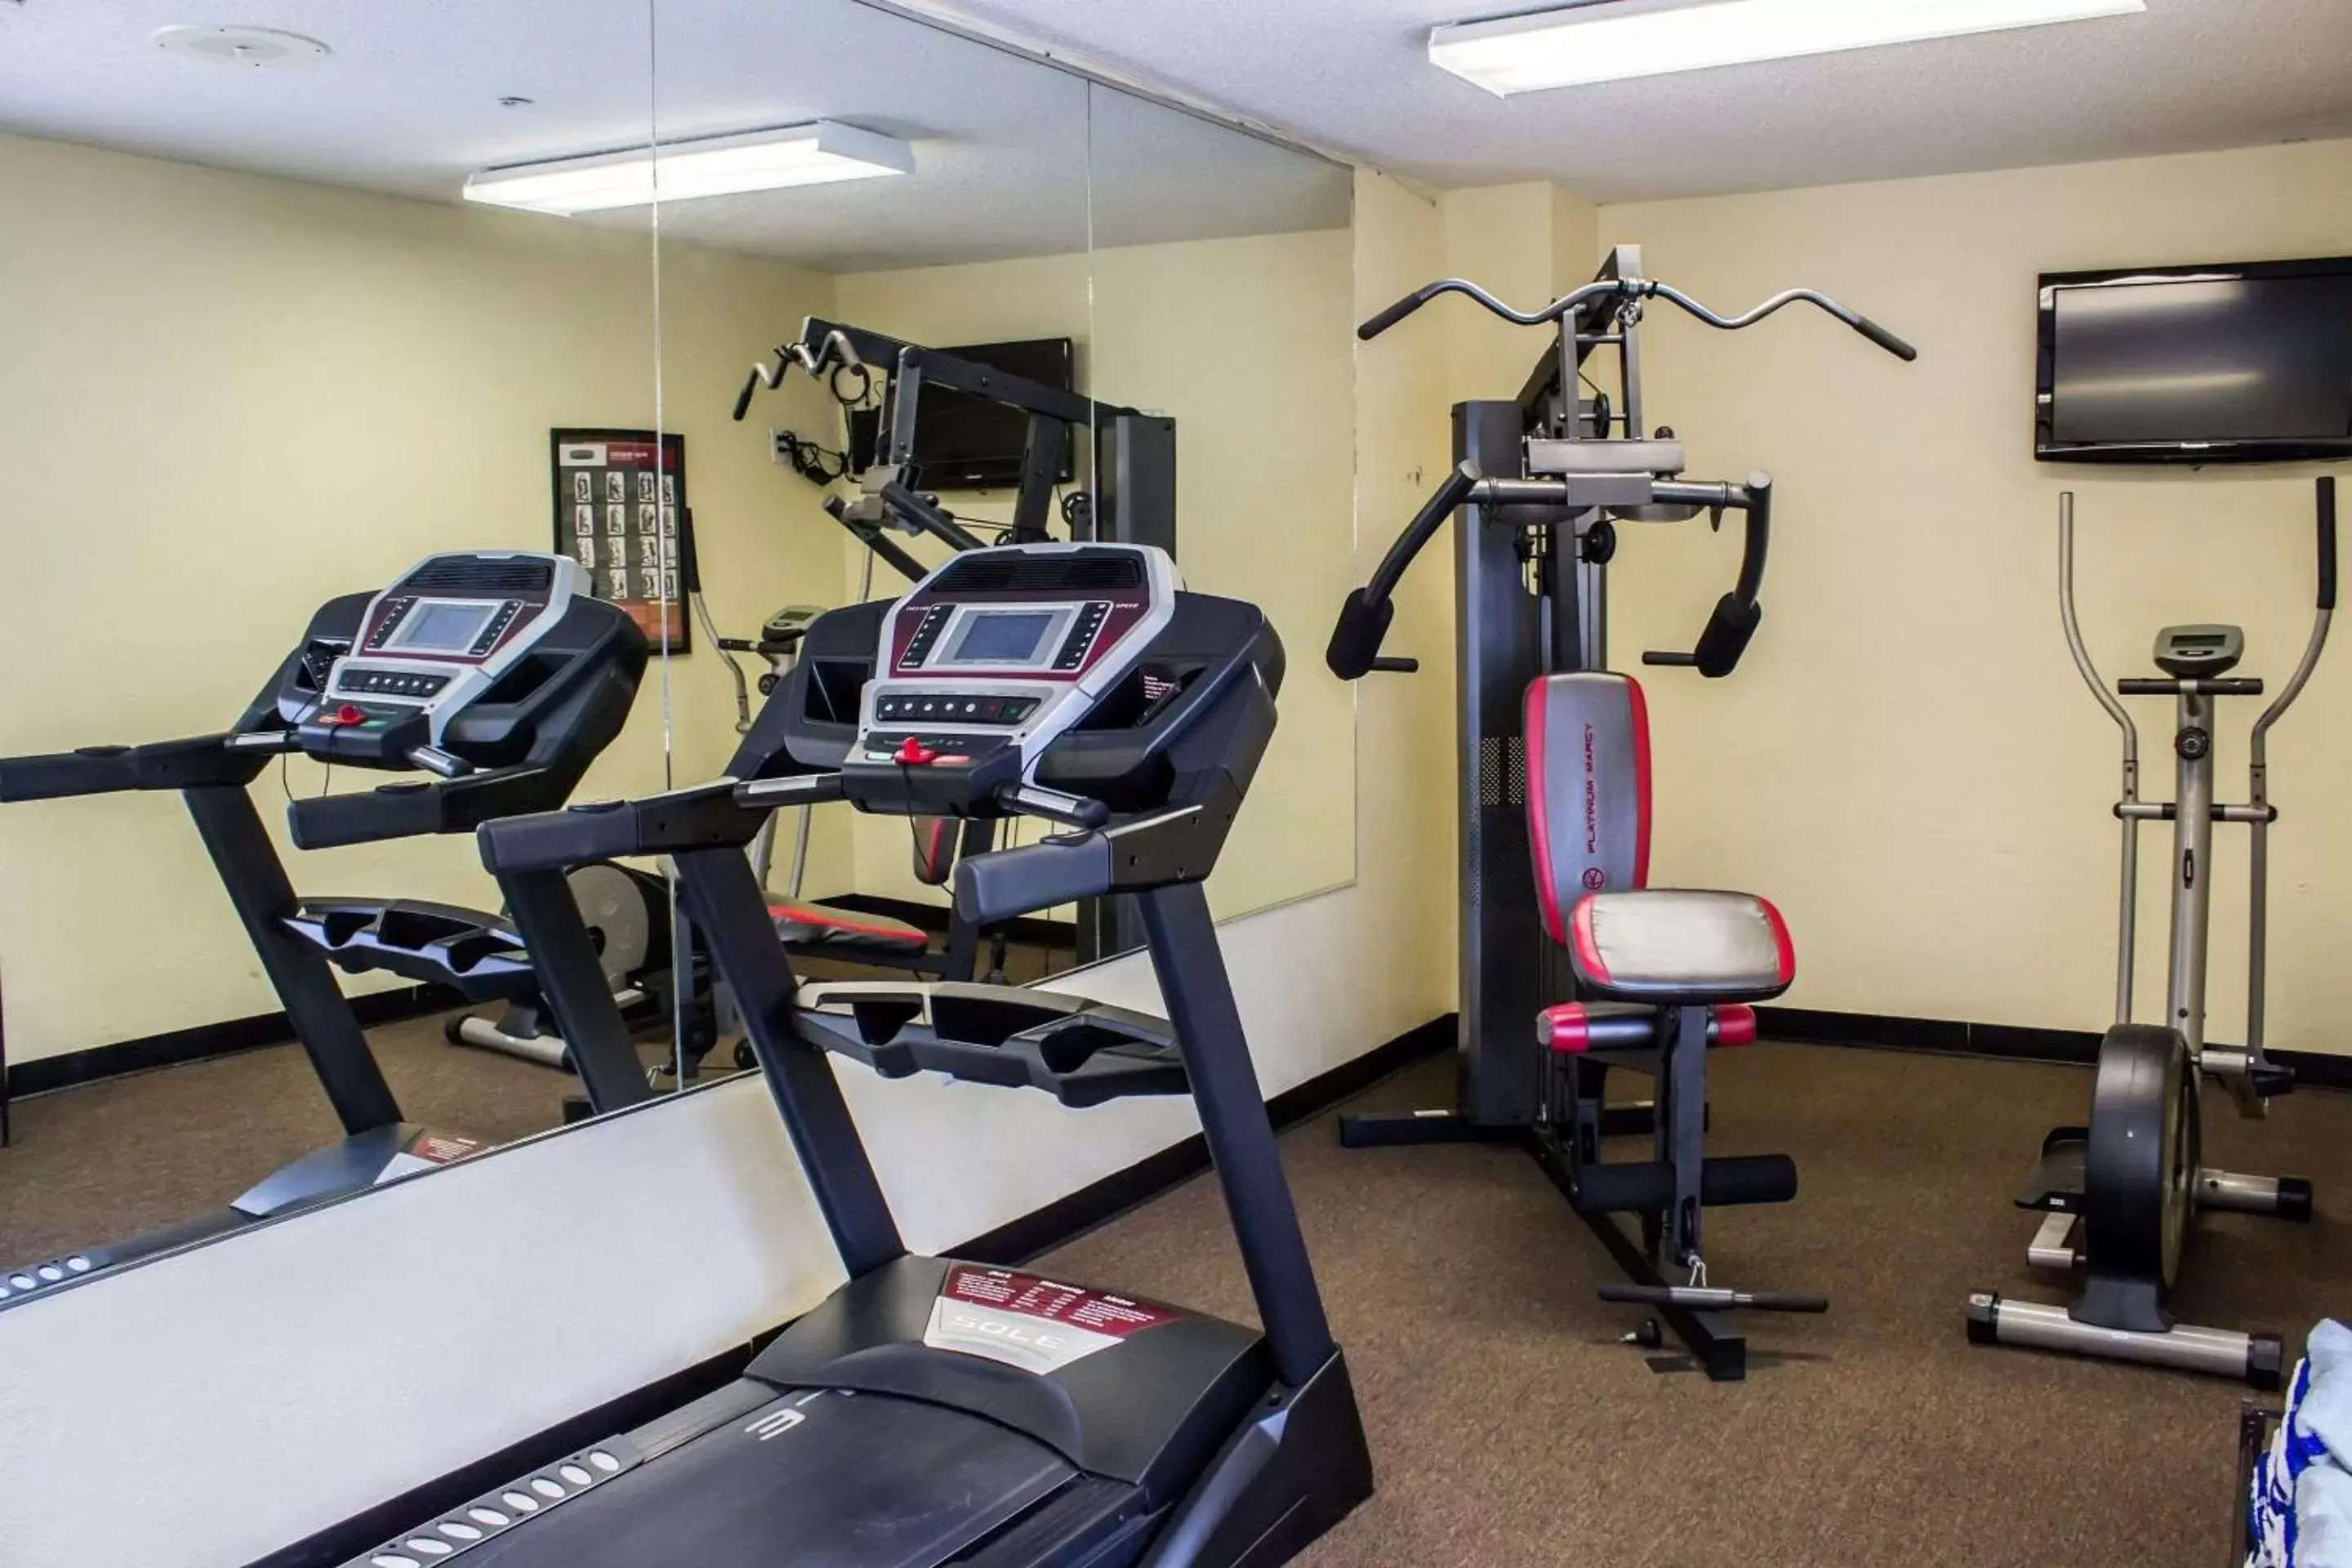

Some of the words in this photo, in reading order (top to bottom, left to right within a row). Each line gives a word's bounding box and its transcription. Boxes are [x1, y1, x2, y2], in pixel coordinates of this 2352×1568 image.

[1584, 723, 1594, 773] MARCY
[1586, 780, 1597, 853] PLATINUM
[950, 1314, 1067, 1350] SOLE
